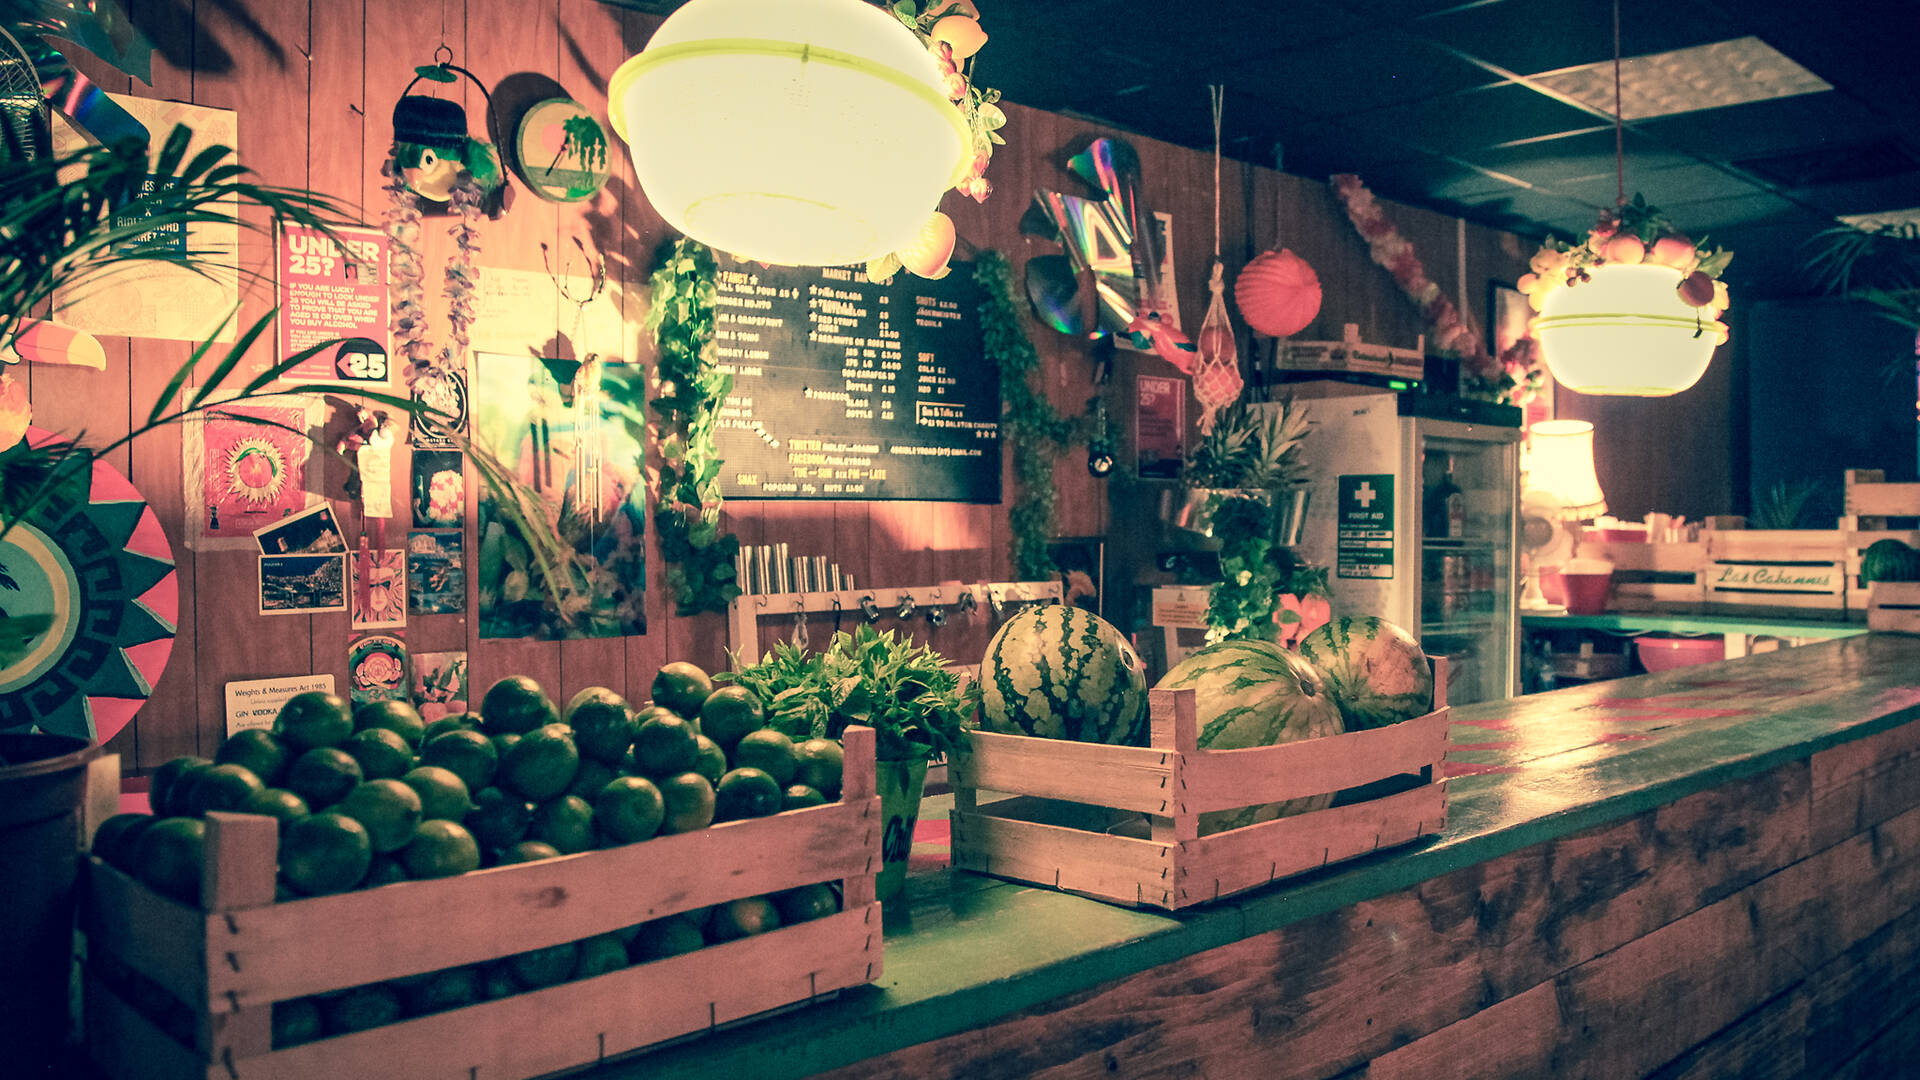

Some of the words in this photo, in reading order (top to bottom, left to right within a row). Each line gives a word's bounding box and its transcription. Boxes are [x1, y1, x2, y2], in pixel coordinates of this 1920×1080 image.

[289, 234, 379, 262] UNDER
[289, 254, 335, 277] 25?
[331, 285, 355, 293] LUCKY
[290, 290, 321, 298] ENOUGH
[355, 294, 379, 302] UNDER
[302, 304, 326, 312] PROVE
[350, 353, 386, 379] 25
[1371, 512, 1384, 520] AID
[1717, 567, 1750, 583] Las
[1753, 568, 1831, 586] Cabannes
[235, 688, 260, 698] Weights
[262, 687, 268, 695] &
[268, 686, 298, 695] Measures
[235, 710, 249, 718] GIN
[252, 708, 278, 717] VODKA
